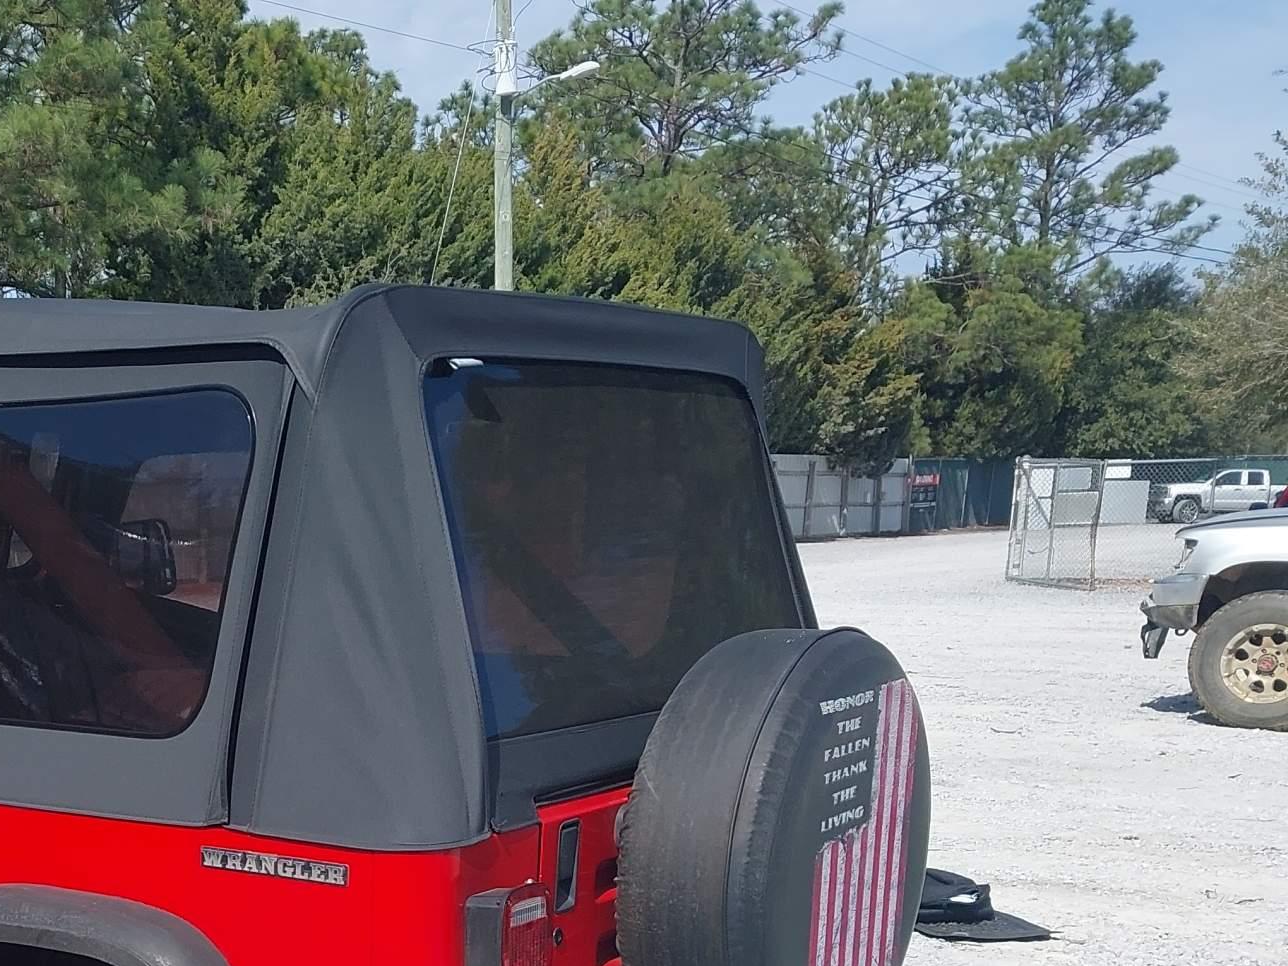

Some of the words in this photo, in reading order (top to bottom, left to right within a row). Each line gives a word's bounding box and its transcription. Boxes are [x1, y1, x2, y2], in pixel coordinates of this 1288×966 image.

[819, 690, 874, 715] HONOR
[837, 716, 862, 735] THE
[824, 737, 870, 762] FALLEN
[824, 760, 868, 785] THANK
[832, 785, 857, 805] THE
[820, 805, 864, 832] LIVING
[202, 848, 346, 885] WRANGLER
